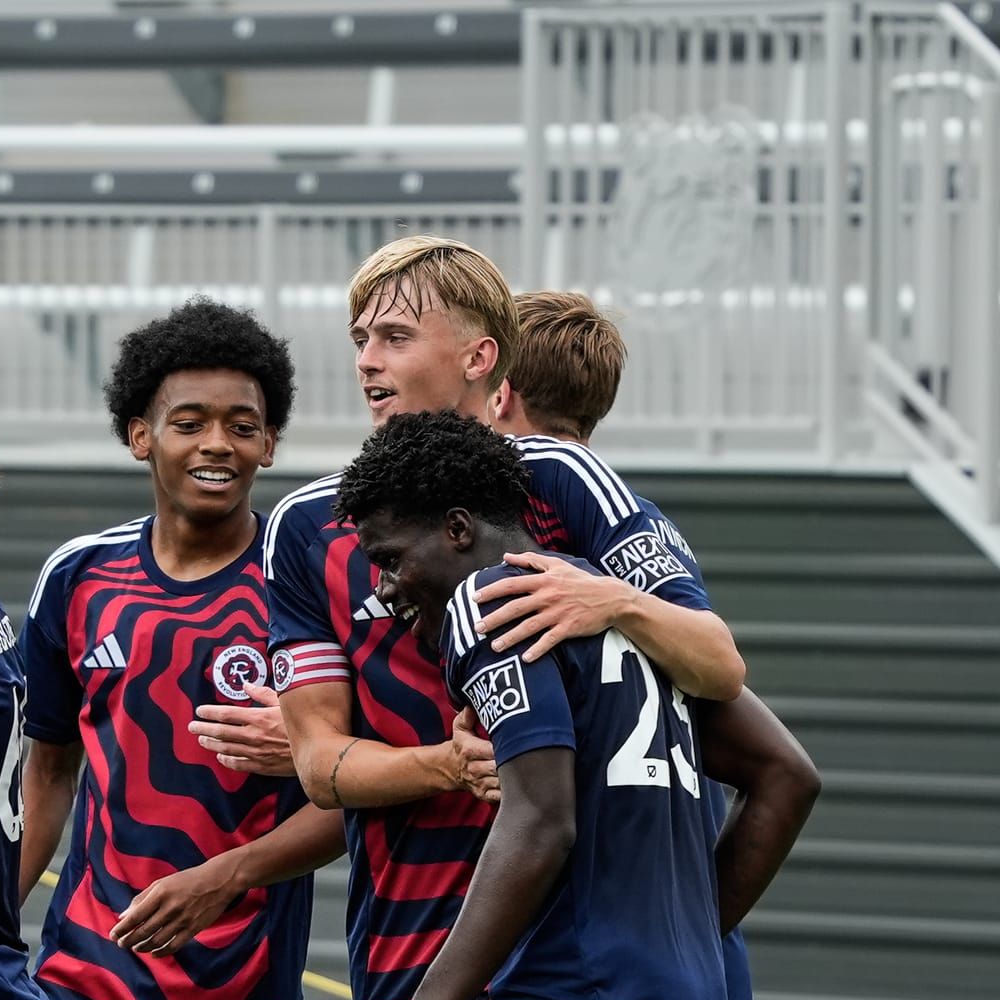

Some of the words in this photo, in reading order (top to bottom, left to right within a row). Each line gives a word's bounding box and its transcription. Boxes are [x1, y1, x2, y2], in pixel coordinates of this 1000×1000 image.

[640, 555, 684, 578] PRO
[218, 681, 249, 698] REVOLUTIO
[472, 664, 514, 706] NEXT
[485, 688, 521, 722] PRO
